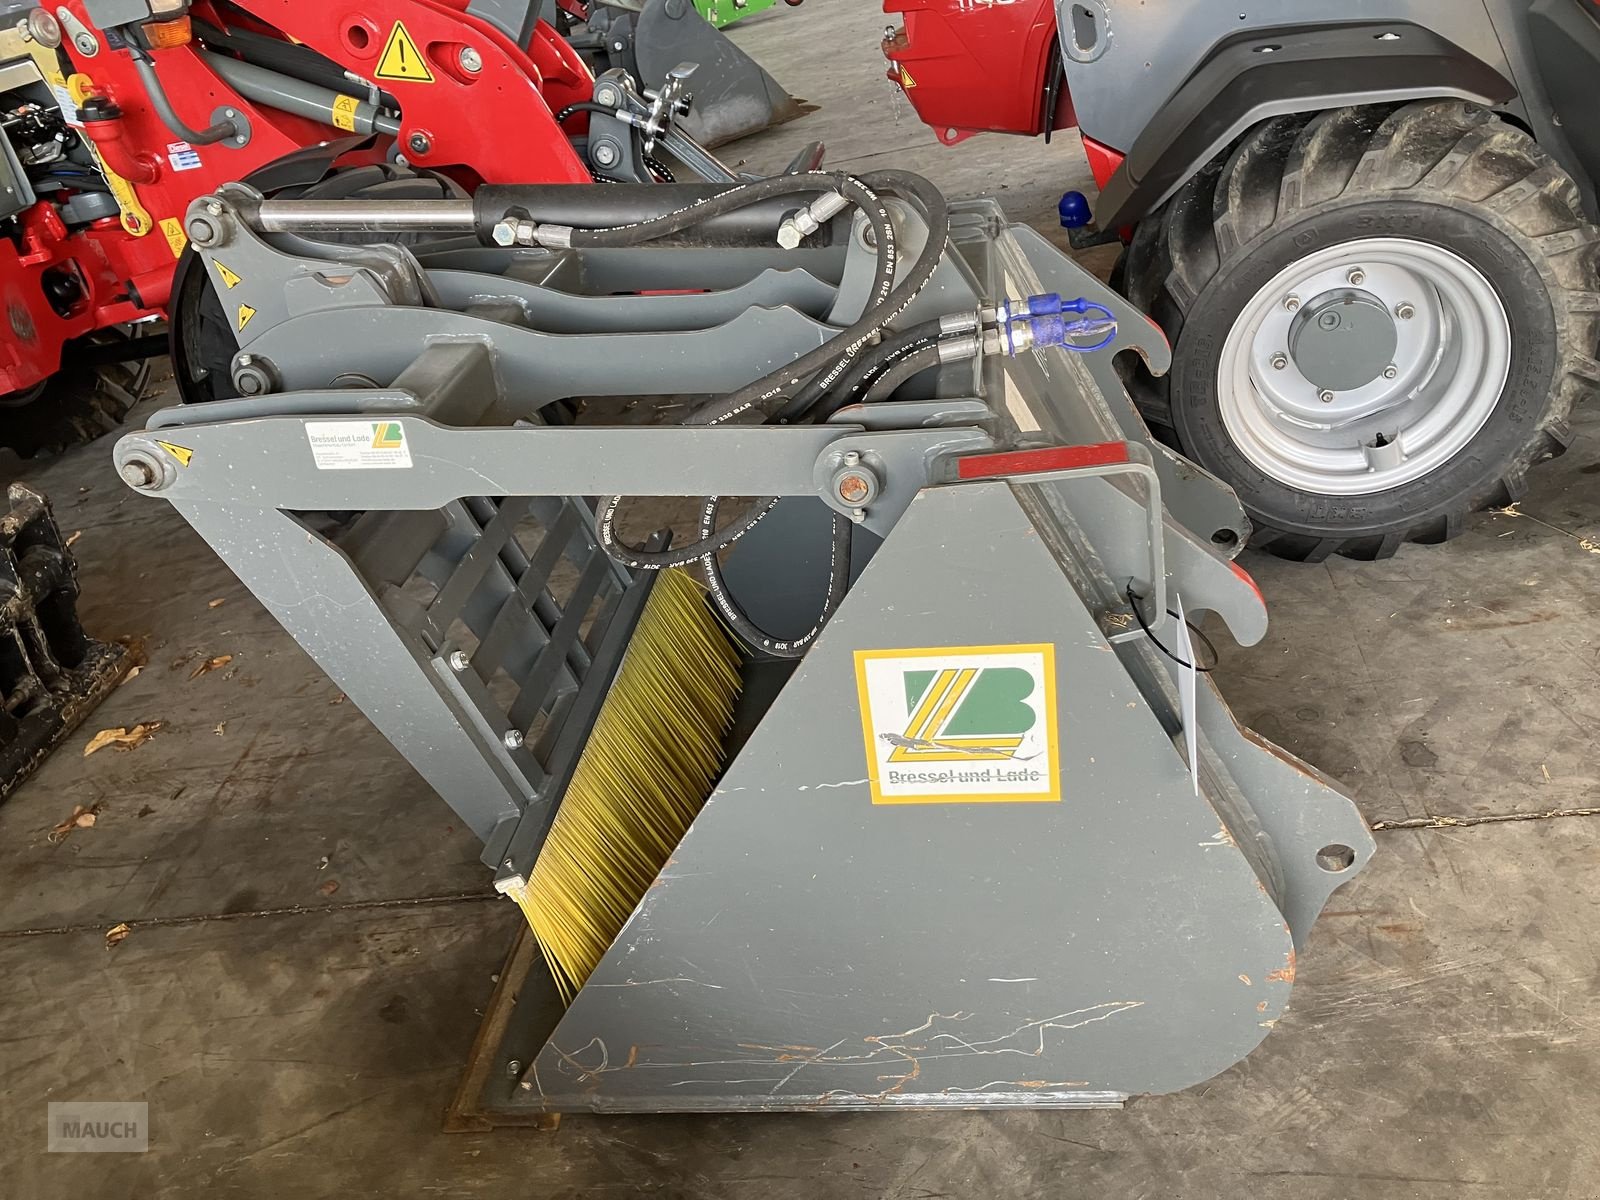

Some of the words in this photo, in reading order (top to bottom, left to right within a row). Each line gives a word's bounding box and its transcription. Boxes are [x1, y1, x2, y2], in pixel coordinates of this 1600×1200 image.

[878, 208, 888, 218] 10
[886, 244, 895, 260] 853
[885, 261, 895, 275] EN
[880, 281, 891, 297] 210
[881, 311, 898, 327] UND
[819, 358, 851, 389] BRESSEL
[733, 402, 752, 414] BAR
[610, 495, 621, 508] LAD
[709, 576, 719, 592] UND
[716, 592, 738, 621] BRESSEL
[888, 769, 954, 784] Bressel
[957, 768, 991, 783] und
[996, 767, 1040, 782] Lade
